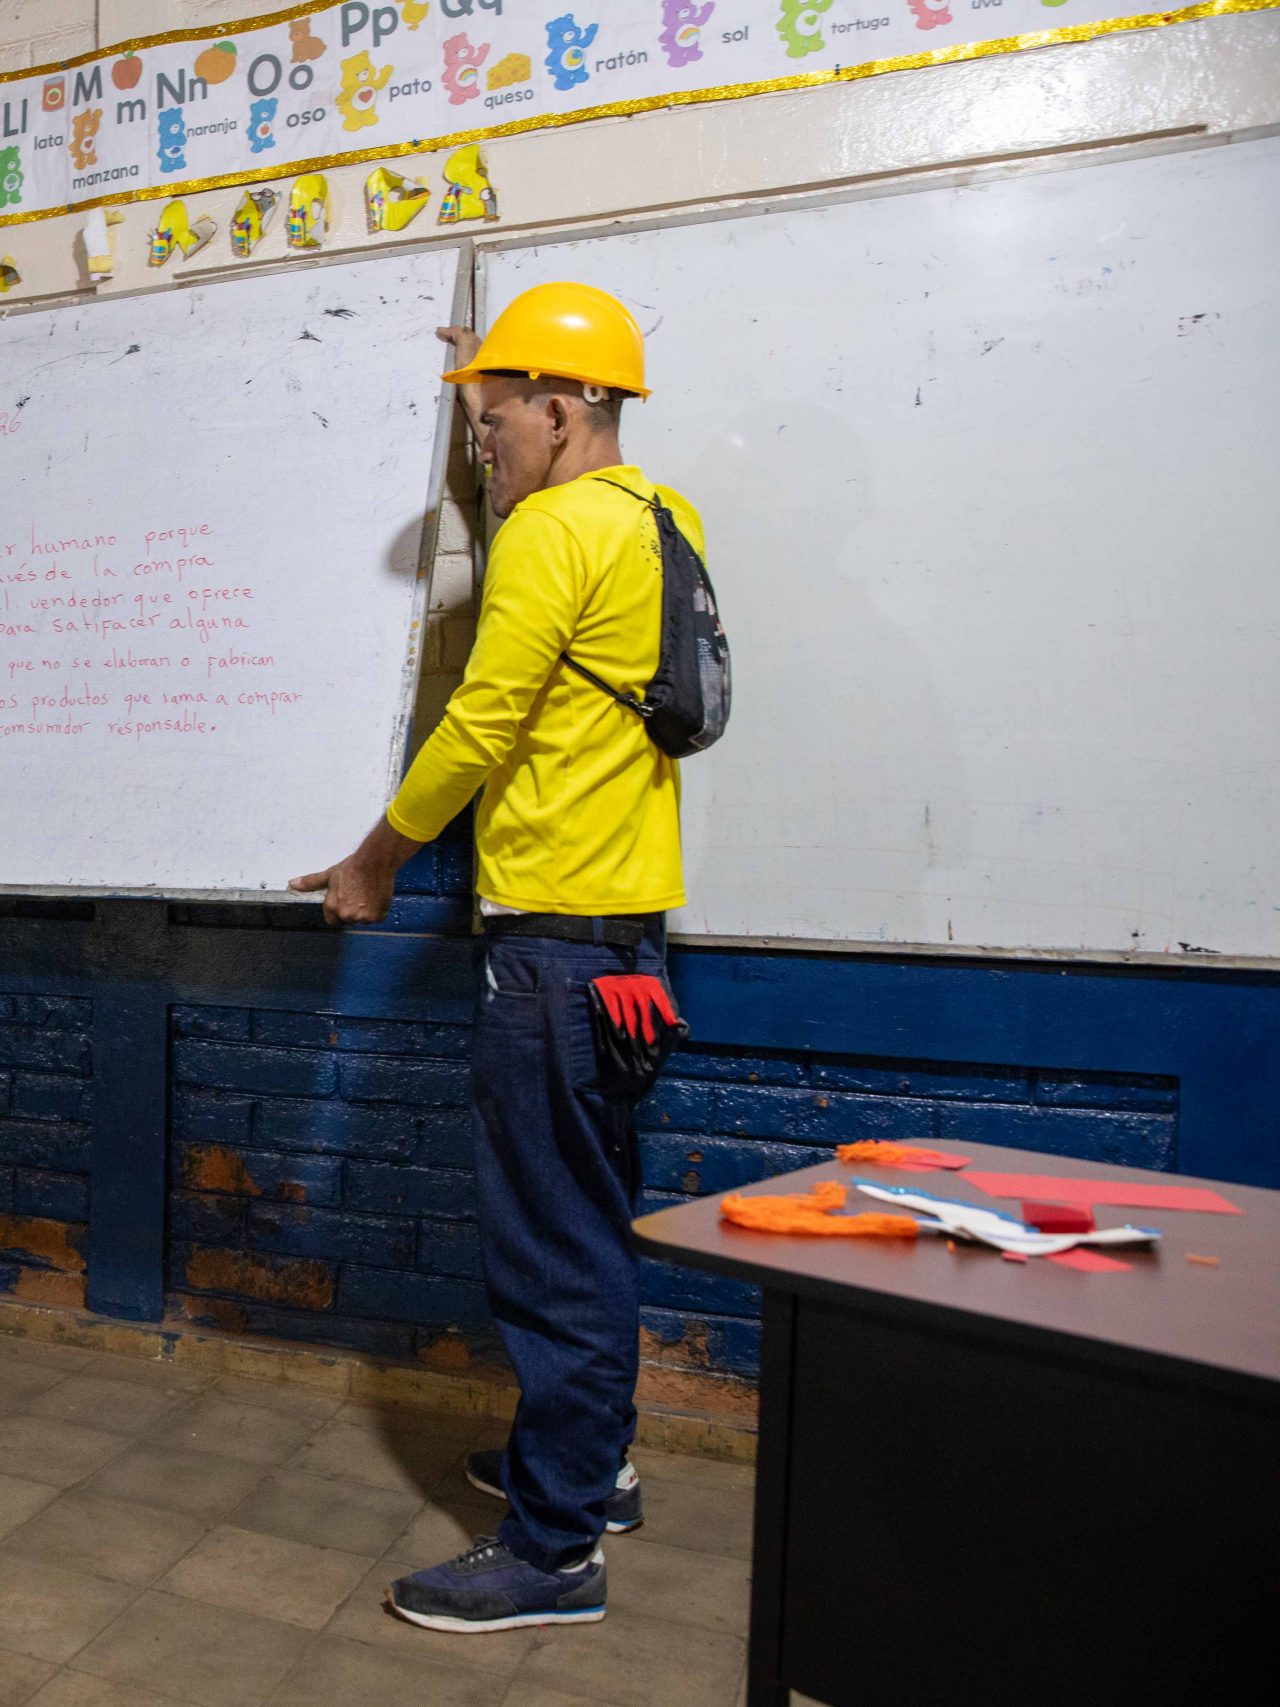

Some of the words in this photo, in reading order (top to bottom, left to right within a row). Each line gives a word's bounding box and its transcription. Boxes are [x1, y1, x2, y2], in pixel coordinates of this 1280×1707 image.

[341, 1, 399, 47] Pp
[722, 25, 749, 45] sol
[830, 13, 890, 37] tortuga
[595, 49, 648, 73] ratón
[72, 65, 103, 106] M
[116, 98, 146, 125] m
[156, 68, 208, 109] Nn
[389, 77, 432, 102] pato
[483, 87, 535, 110] queso
[3, 98, 28, 138] Ll
[186, 117, 238, 138] naranja
[285, 106, 326, 128] oso
[33, 133, 64, 150] lata
[73, 164, 139, 190] manzana
[31, 520, 117, 555] humano
[144, 524, 215, 556] porque
[45, 560, 72, 581] de
[94, 555, 118, 577] la
[133, 554, 215, 582] compra
[31, 588, 124, 609] vendedor
[134, 593, 173, 618] que
[188, 587, 255, 611] ofrece
[169, 606, 249, 643] alguna
[8, 659, 35, 679] que
[42, 658, 62, 670] no
[72, 657, 92, 668] se
[104, 647, 171, 669] elaboran
[180, 657, 191, 667] o
[32, 682, 109, 720] productos
[125, 693, 152, 716] que
[216, 694, 229, 706] a
[239, 691, 303, 715] comprar
